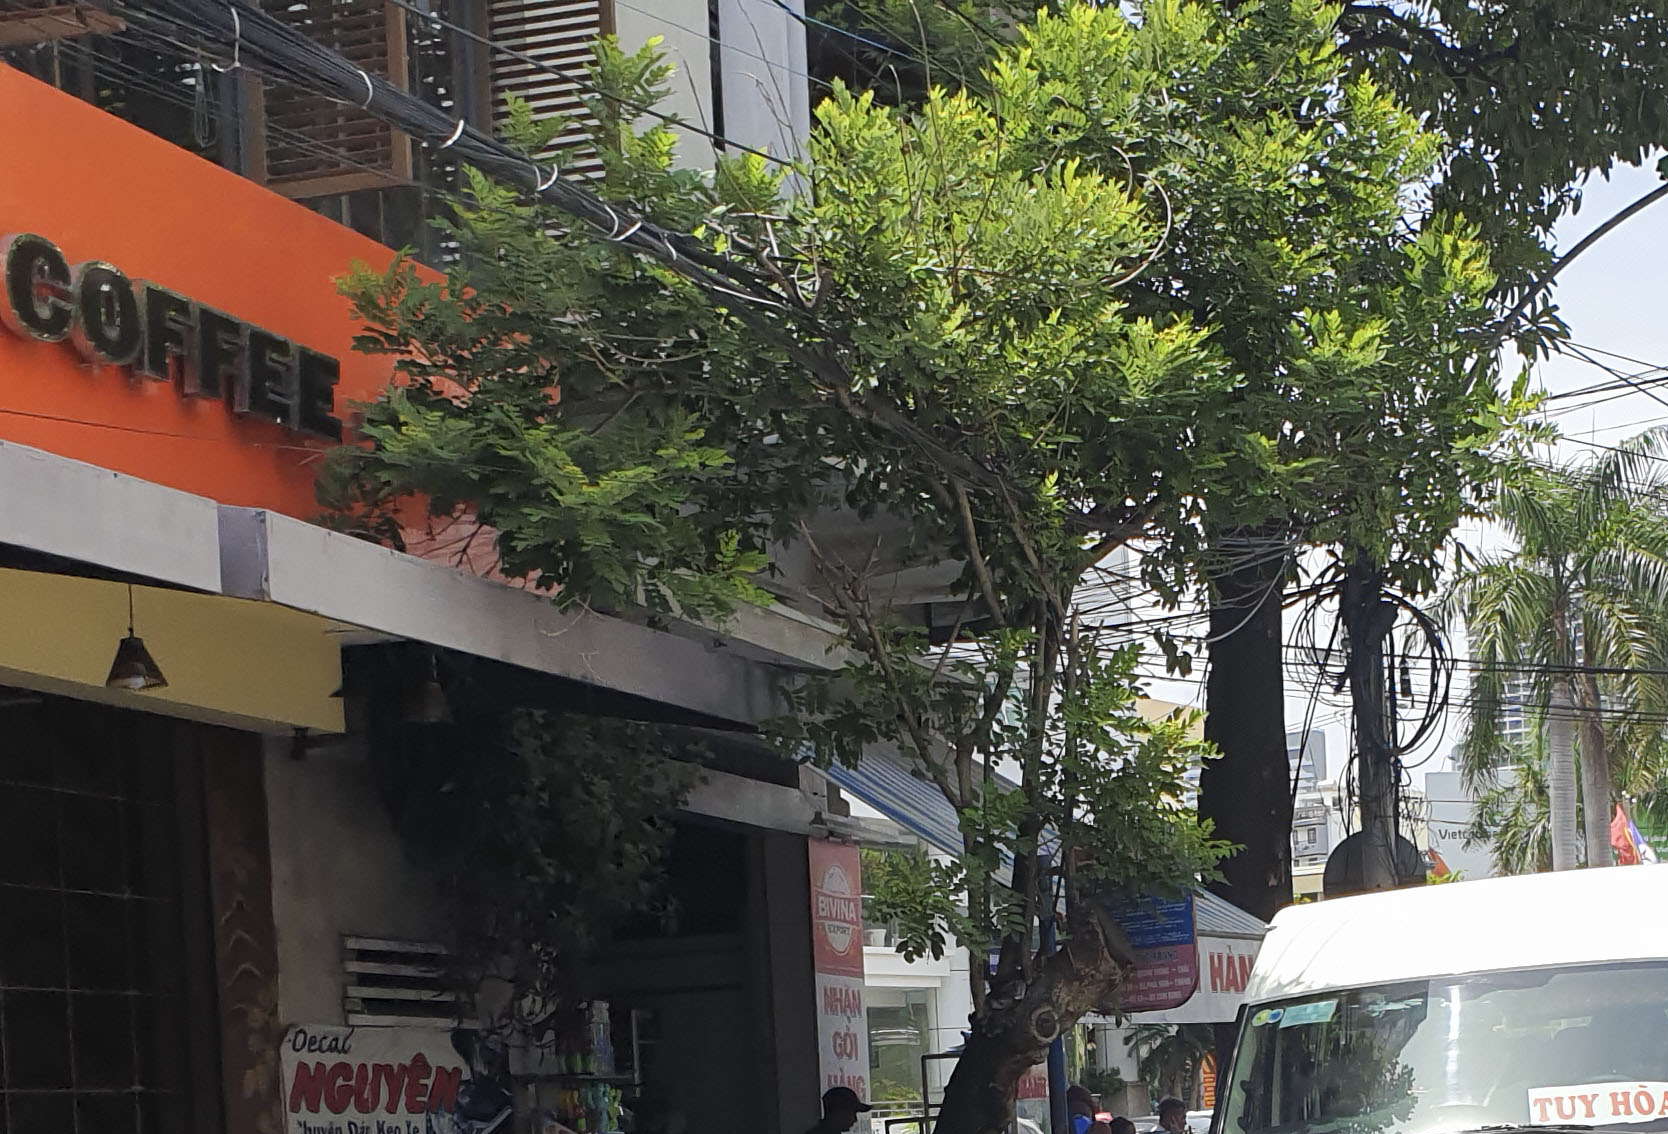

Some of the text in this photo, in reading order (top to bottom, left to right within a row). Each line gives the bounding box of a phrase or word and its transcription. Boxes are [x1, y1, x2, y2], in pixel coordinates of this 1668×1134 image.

[4, 232, 341, 441] COFFEE
[817, 896, 857, 921] BIVINA
[290, 1027, 355, 1054] Decal
[1533, 1093, 1599, 1122] TUY
